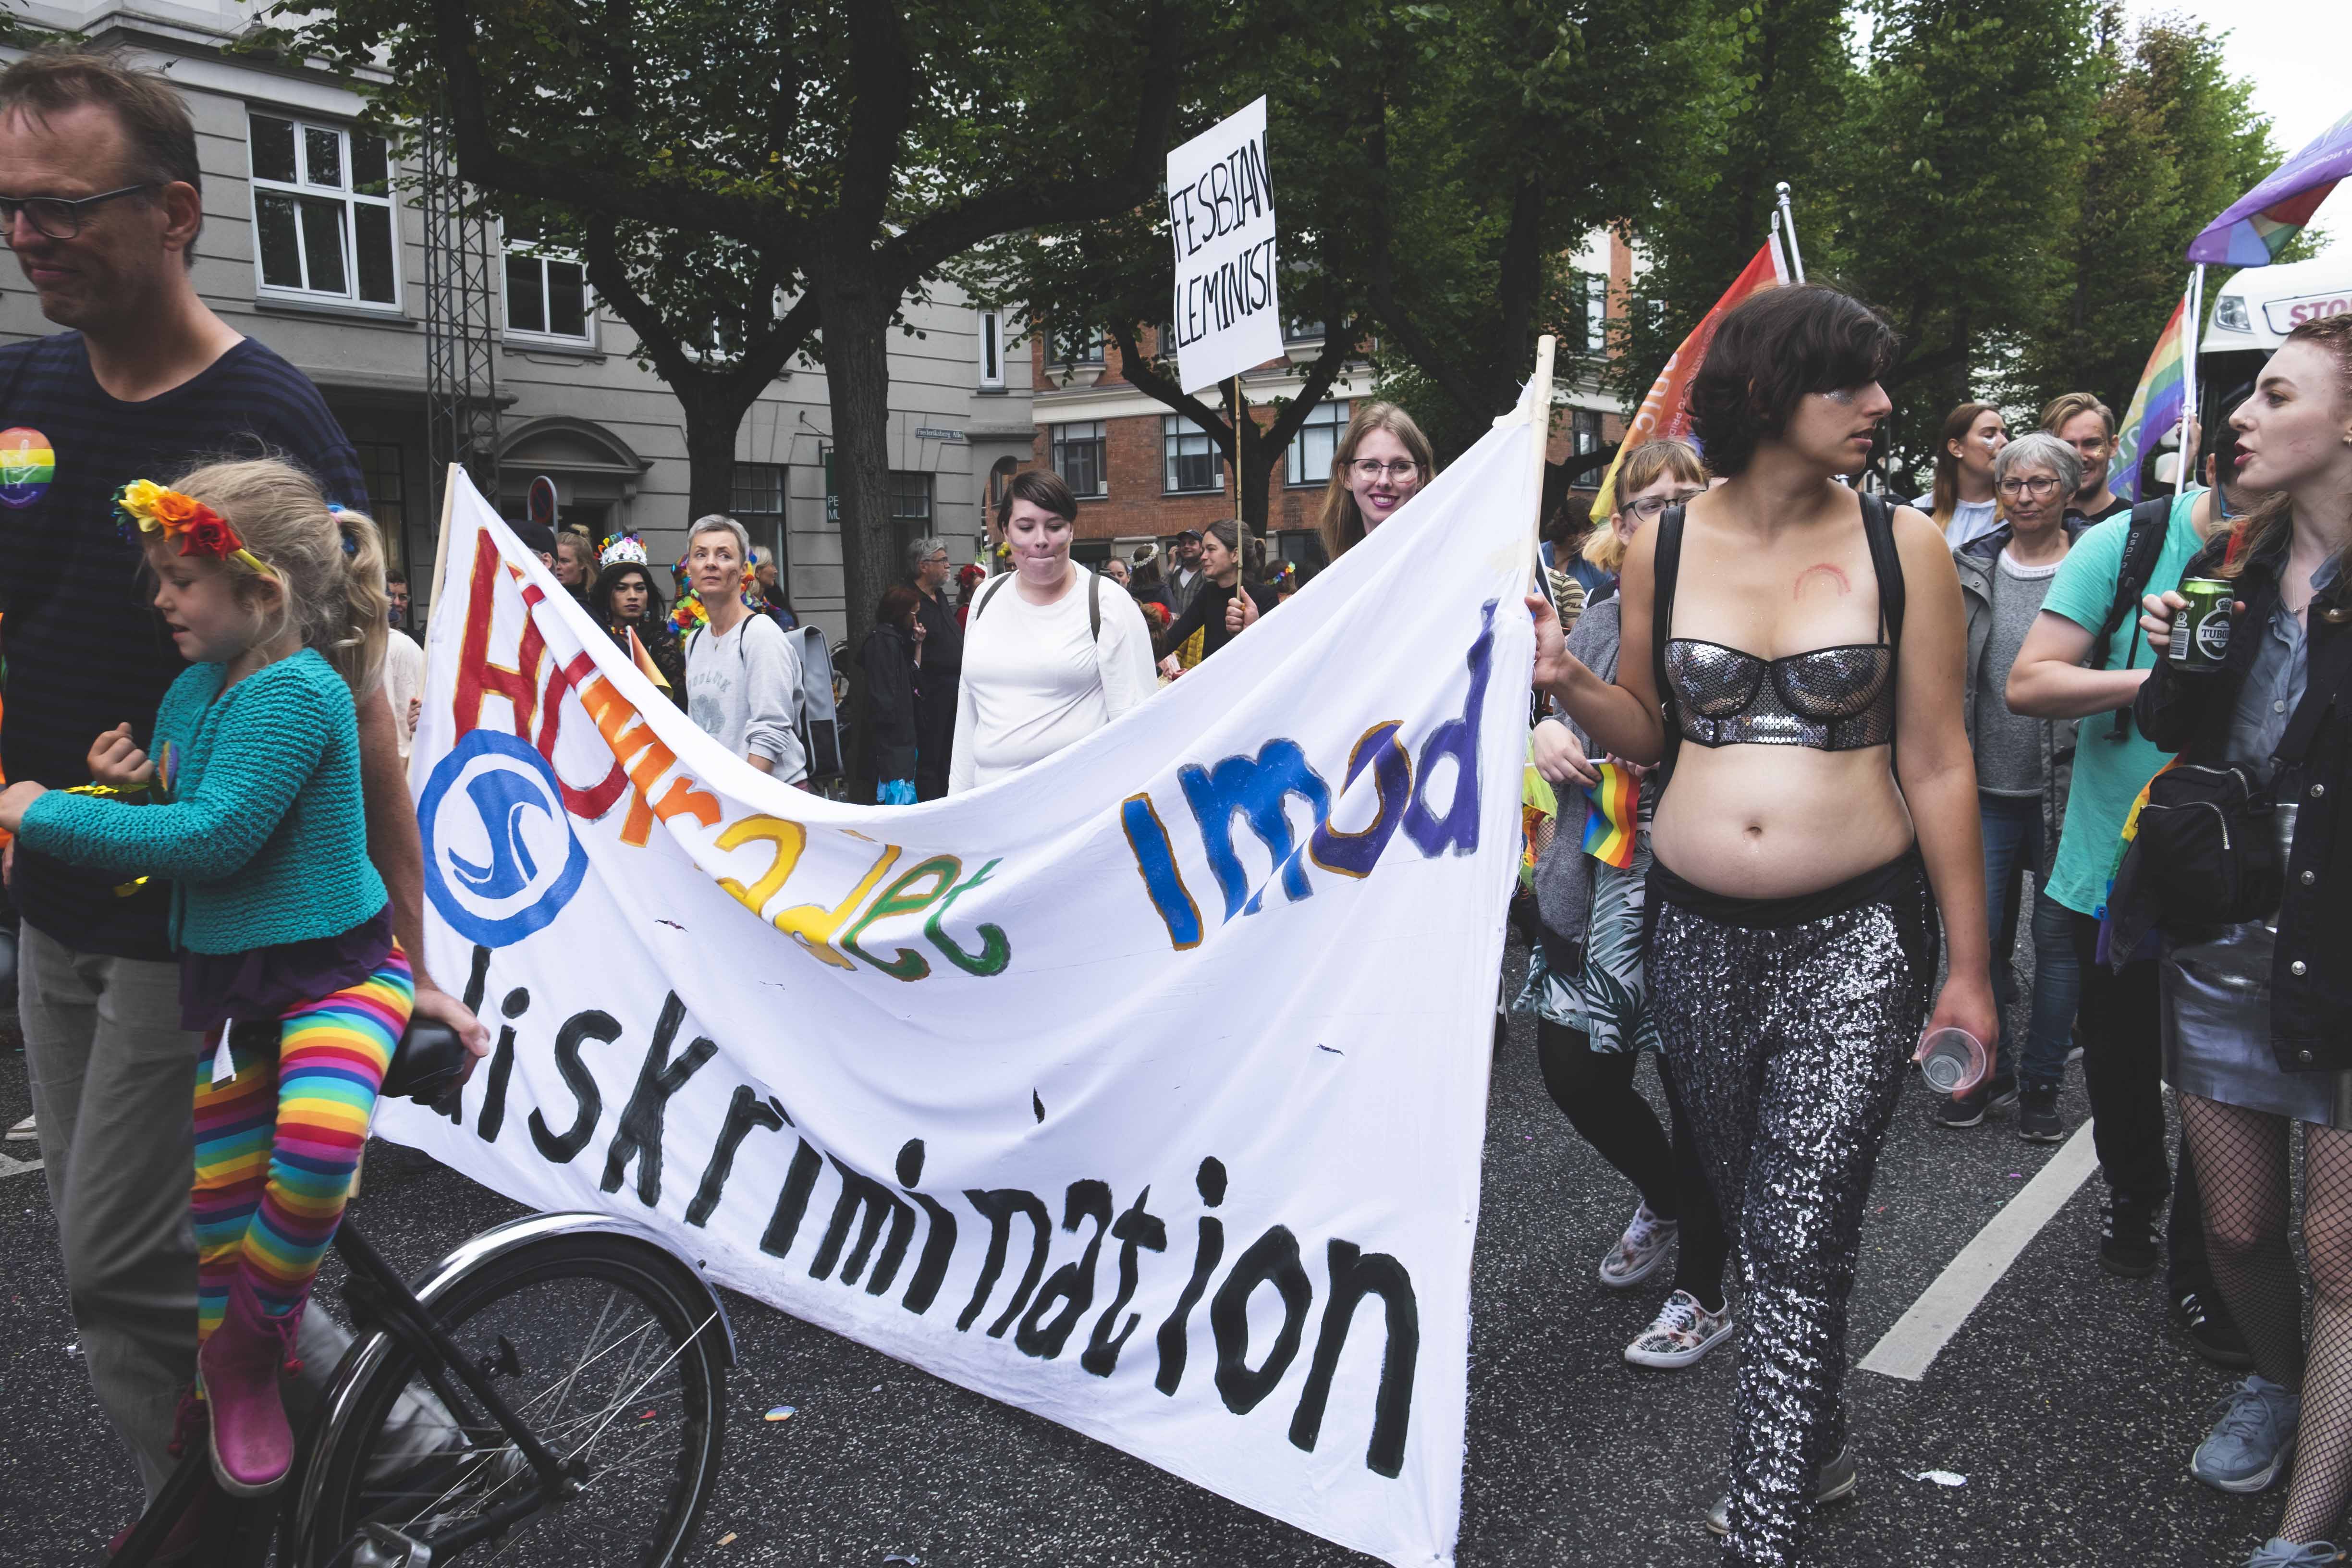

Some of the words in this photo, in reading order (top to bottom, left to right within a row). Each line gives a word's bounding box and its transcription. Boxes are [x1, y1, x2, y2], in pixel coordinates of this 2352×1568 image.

[1169, 129, 1273, 263] FESBIAN
[1176, 236, 1275, 348] LEMINIST
[2290, 298, 2352, 327] STO
